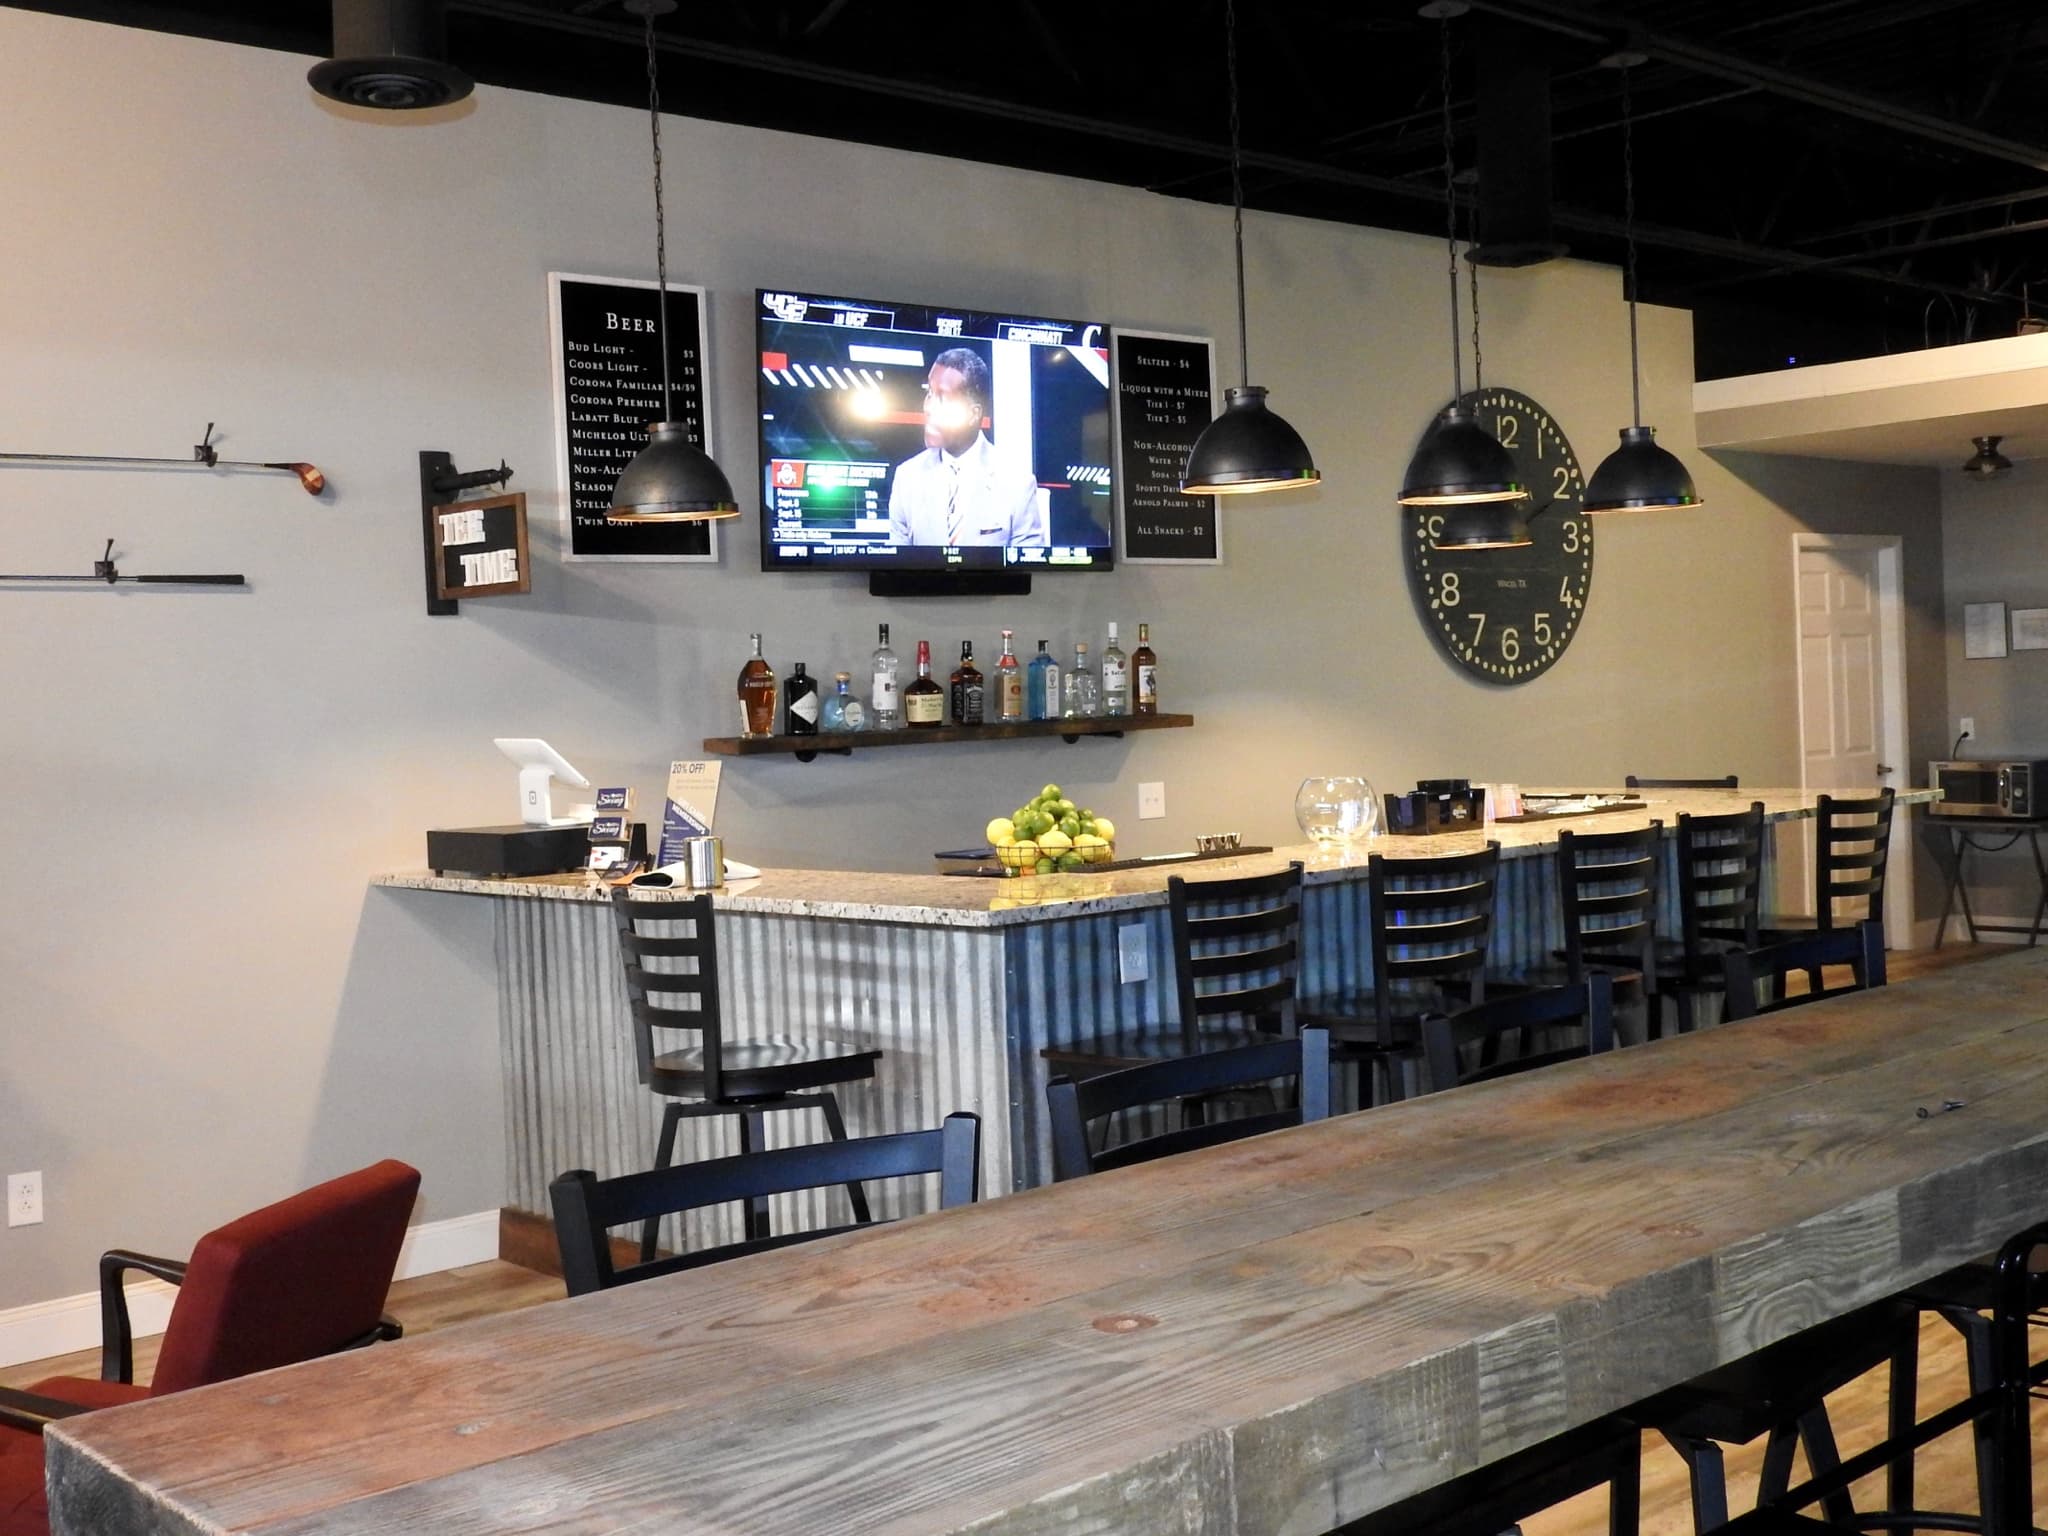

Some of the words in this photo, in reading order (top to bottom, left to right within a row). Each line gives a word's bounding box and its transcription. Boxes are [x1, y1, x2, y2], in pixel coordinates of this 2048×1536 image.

[606, 312, 656, 332] BEER
[568, 341, 590, 352] BUD
[594, 343, 625, 354] LIGHT
[569, 359, 603, 370] COORS
[608, 361, 639, 372] LIGHT
[570, 376, 612, 388] CORONA
[616, 379, 663, 391] FAMILIAR
[1120, 382, 1151, 394] LIQUOR
[1154, 386, 1173, 395] WITH
[571, 394, 613, 406] CORONA
[617, 397, 660, 408] PREMIER
[572, 411, 609, 422] LABATT
[614, 413, 639, 424] BLUE
[572, 429, 626, 441] MICHELOB
[630, 432, 650, 441] ULT
[1496, 415, 1519, 448] 12
[574, 446, 611, 457] MILLER
[1134, 440, 1192, 452] NON-ALCOHOL
[574, 464, 623, 475] NON-ALC
[1151, 470, 1169, 479] SODA
[1553, 466, 1570, 499] 2
[576, 499, 612, 509] STELLA
[439, 509, 486, 546] TEE
[576, 516, 603, 526] TWIN
[1137, 526, 1152, 535] ALL
[1154, 525, 1184, 535] SNACKS
[1562, 521, 1579, 553] 3
[460, 548, 519, 587] TIME
[1441, 572, 1460, 607] 8
[1559, 576, 1573, 608] 4
[1468, 613, 1486, 646] 7
[1534, 613, 1551, 646] 5
[1501, 628, 1520, 661] 6
